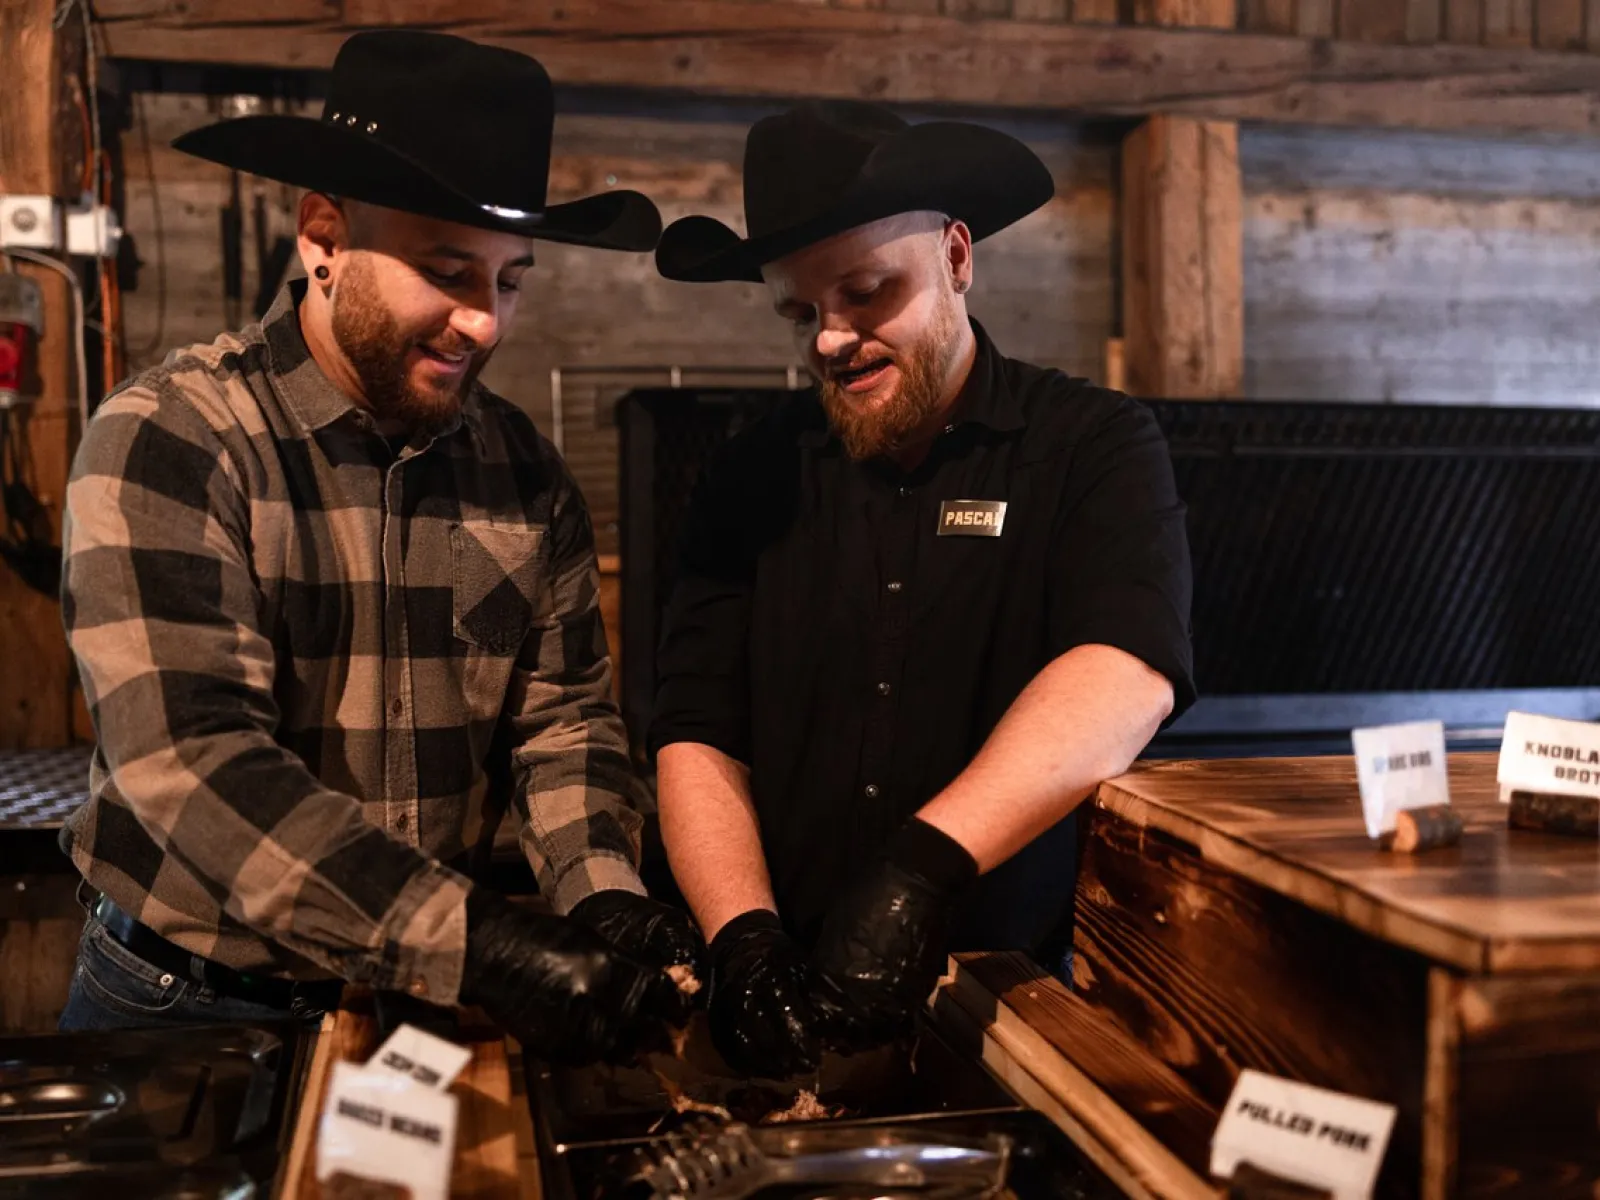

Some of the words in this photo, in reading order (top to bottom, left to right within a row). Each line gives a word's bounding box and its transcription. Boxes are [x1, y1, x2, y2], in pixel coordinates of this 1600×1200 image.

[1555, 765, 1600, 786] BROT
[1238, 1100, 1315, 1135] PULLED
[1318, 1122, 1371, 1153] PORK
